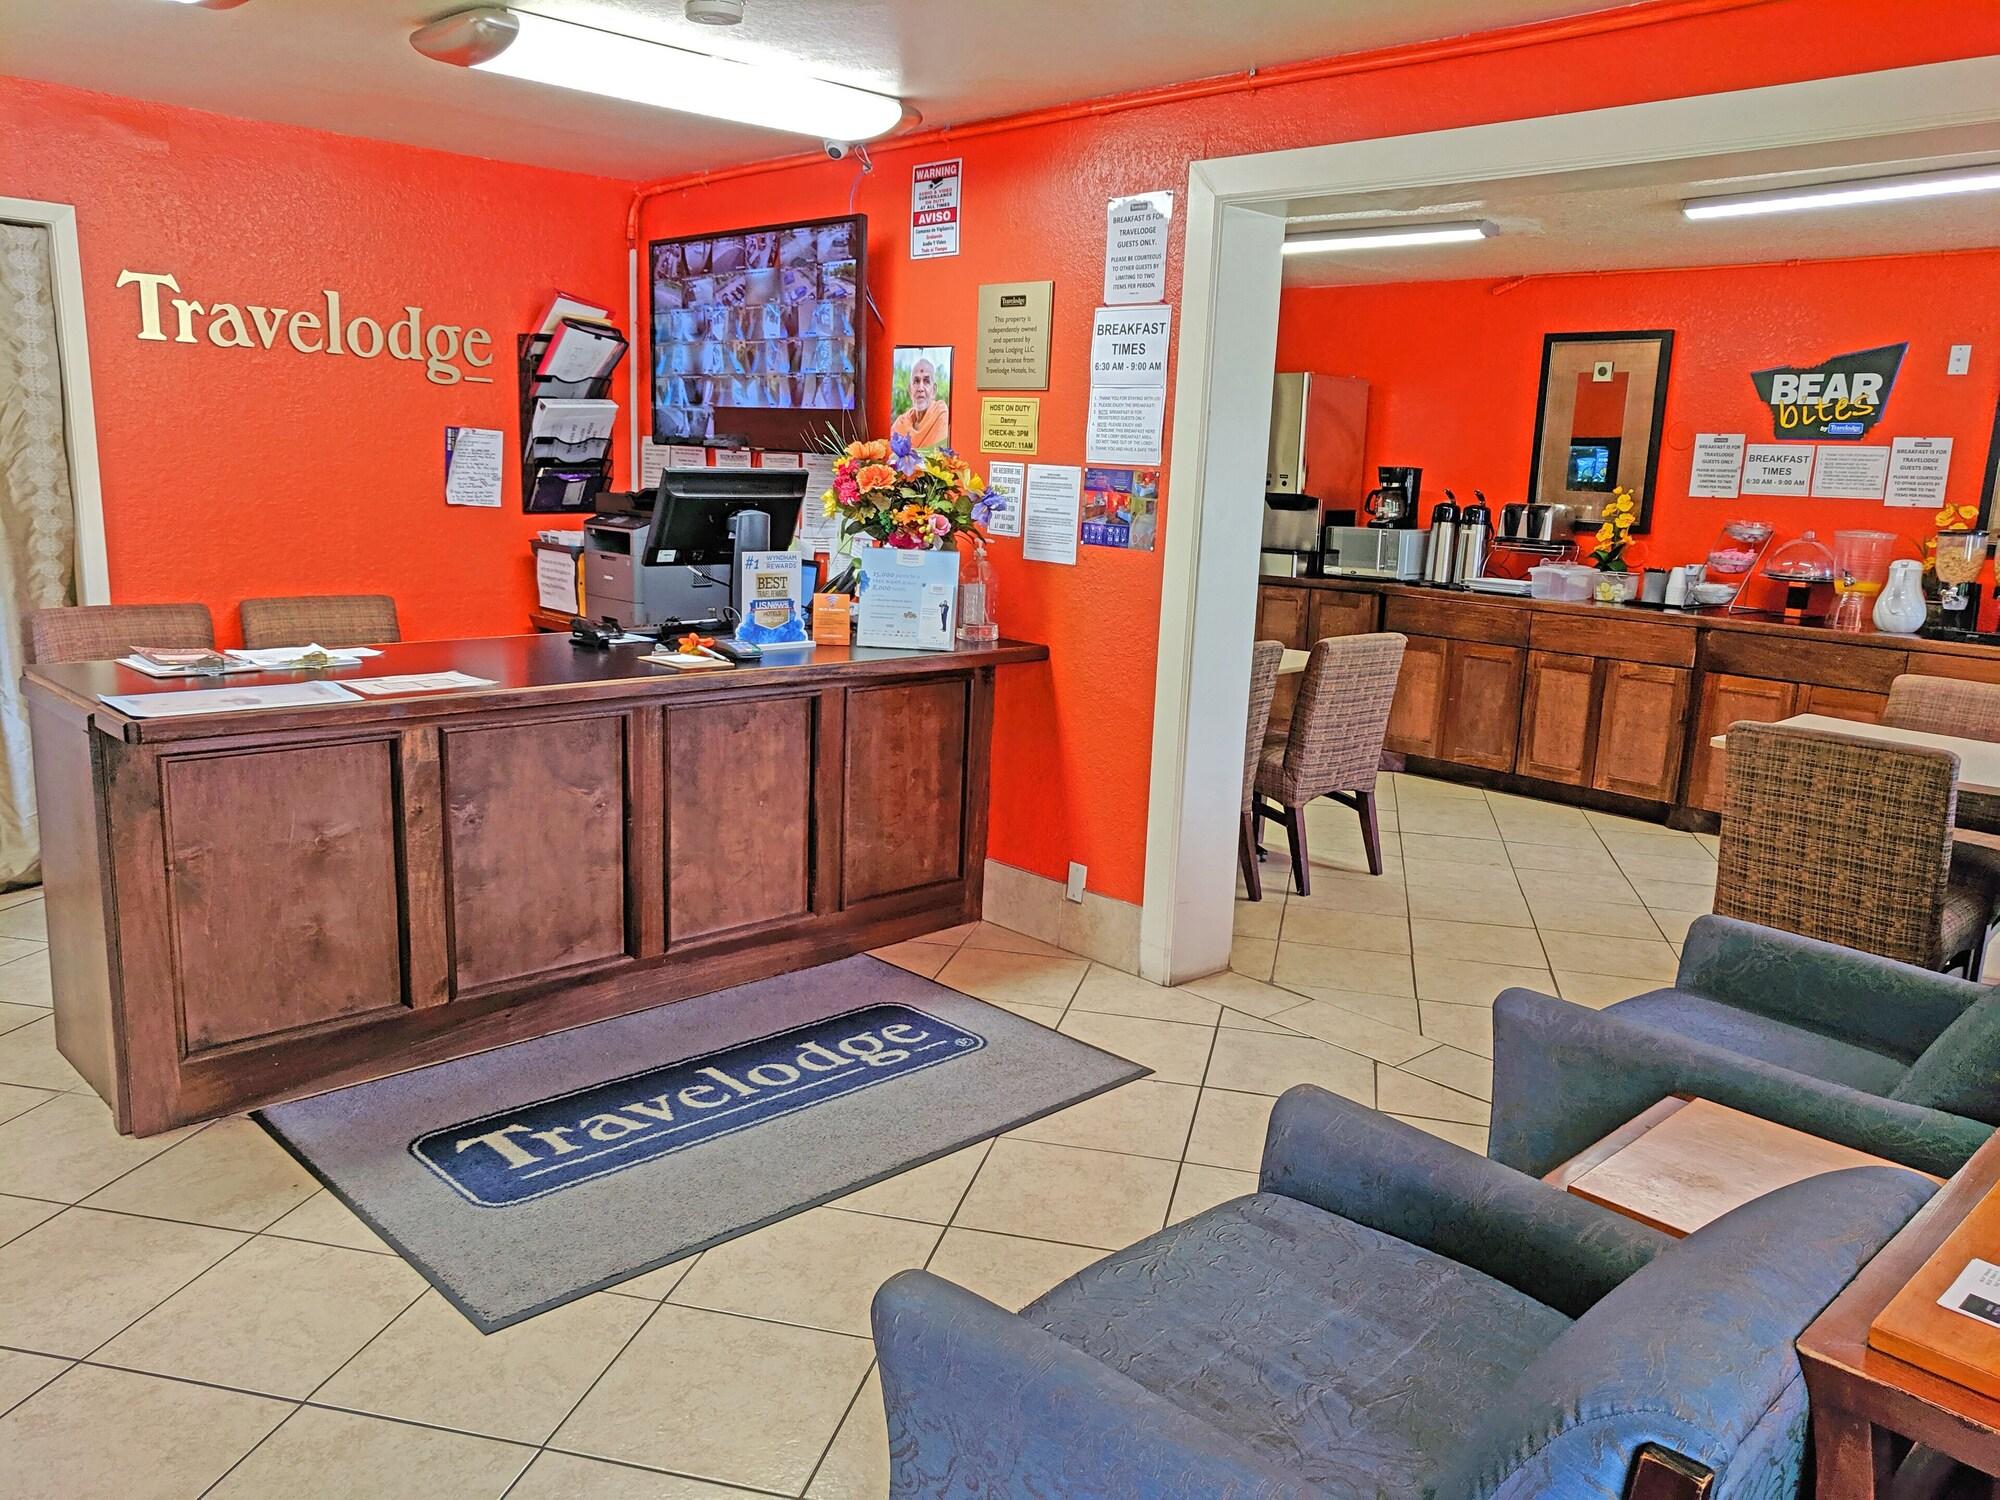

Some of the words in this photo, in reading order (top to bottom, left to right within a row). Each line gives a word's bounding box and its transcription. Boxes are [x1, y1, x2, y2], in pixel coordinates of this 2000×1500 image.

[916, 165, 957, 180] WARNING
[919, 211, 951, 224] AVISO
[1113, 215, 1144, 224] BREAKFAST
[1120, 227, 1156, 236] TRAVELODGE
[1117, 240, 1138, 248] GUESTS
[116, 269, 492, 384] Travelodge
[1097, 322, 1166, 336] BREAKFAST
[1005, 347, 1023, 355] Lodging
[1112, 343, 1145, 355] TIMES
[986, 367, 1009, 375] Travelodge
[1095, 362, 1110, 370] 6:30
[1131, 362, 1146, 370] 9:00
[1149, 362, 1161, 370] AM
[1770, 373, 1884, 405] BEAR
[1779, 393, 1874, 428] bites
[1001, 417, 1017, 425] Danny
[1749, 455, 1810, 463] BREAKFAST
[1762, 467, 1792, 475] TIMES
[745, 556, 759, 570] #1
[758, 577, 788, 589] BEST
[456, 1018, 933, 1172] Travelodge
